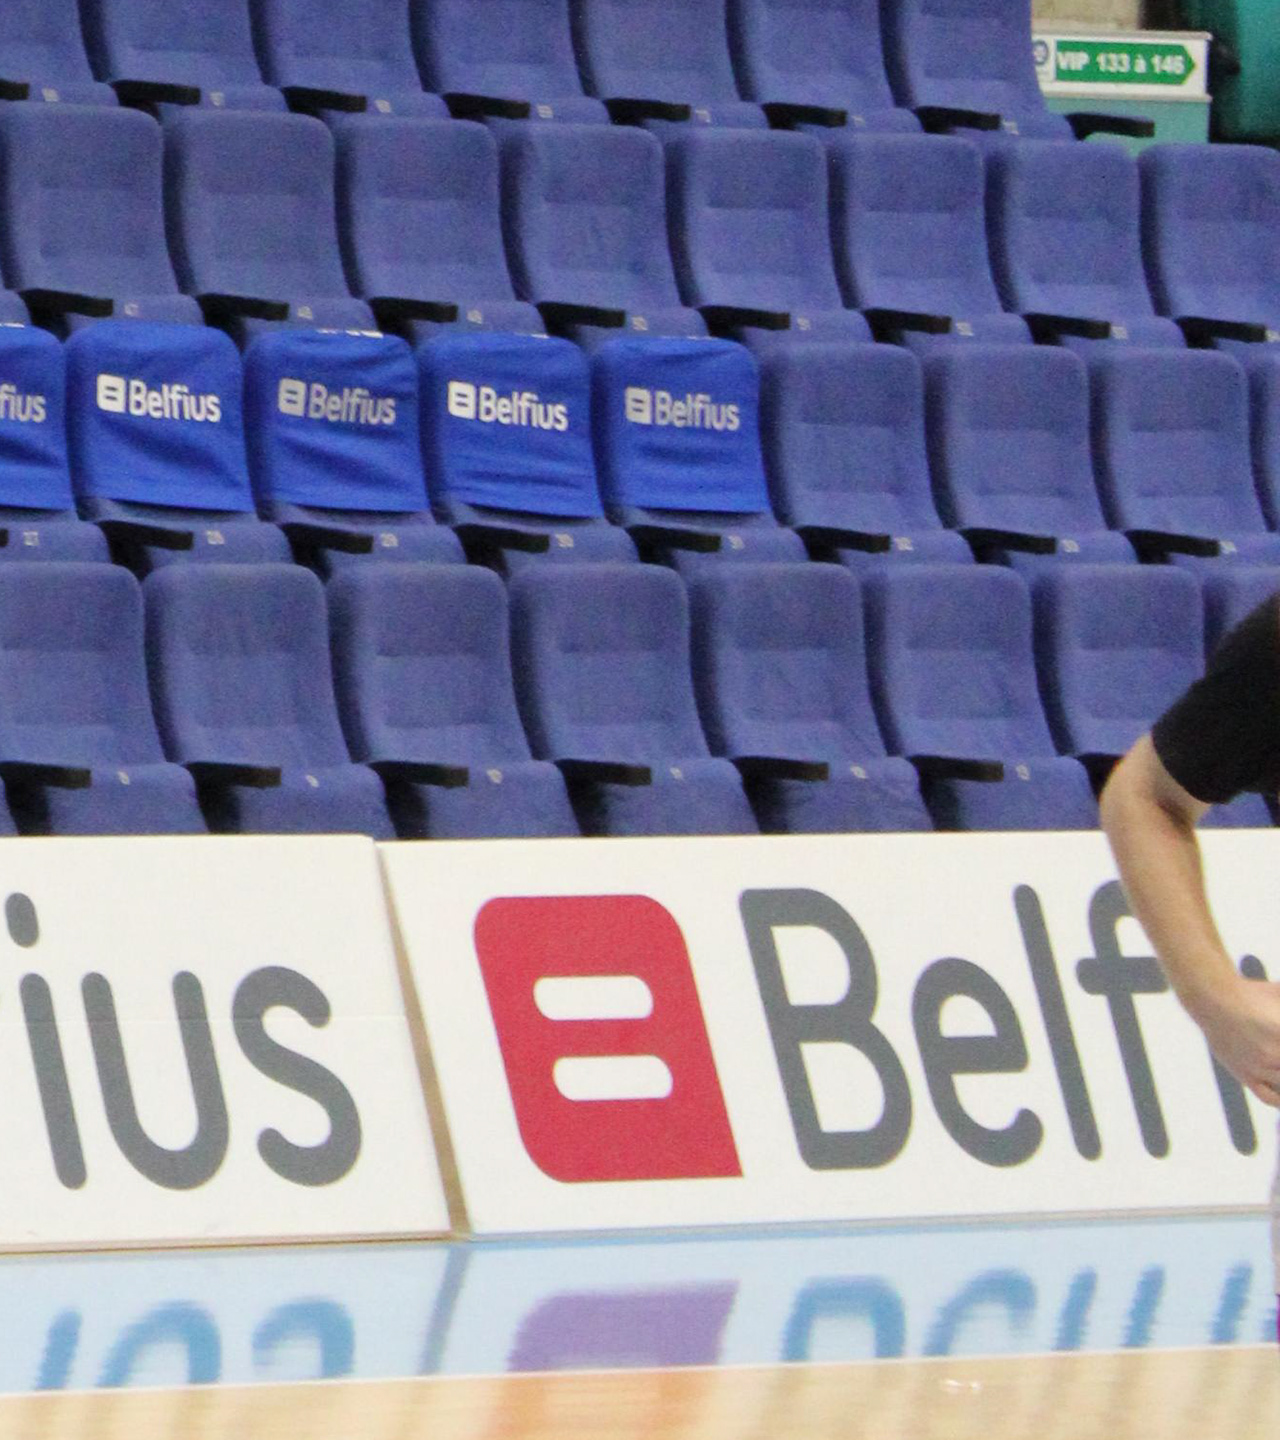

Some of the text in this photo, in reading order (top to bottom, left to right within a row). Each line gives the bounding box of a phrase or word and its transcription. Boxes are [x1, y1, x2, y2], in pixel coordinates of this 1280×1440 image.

[1057, 50, 1146, 74] VIP 133 à
[128, 379, 222, 423] Belfius
[308, 383, 397, 425] Belfius
[479, 386, 570, 431] Belfius
[654, 390, 740, 431] Belfius
